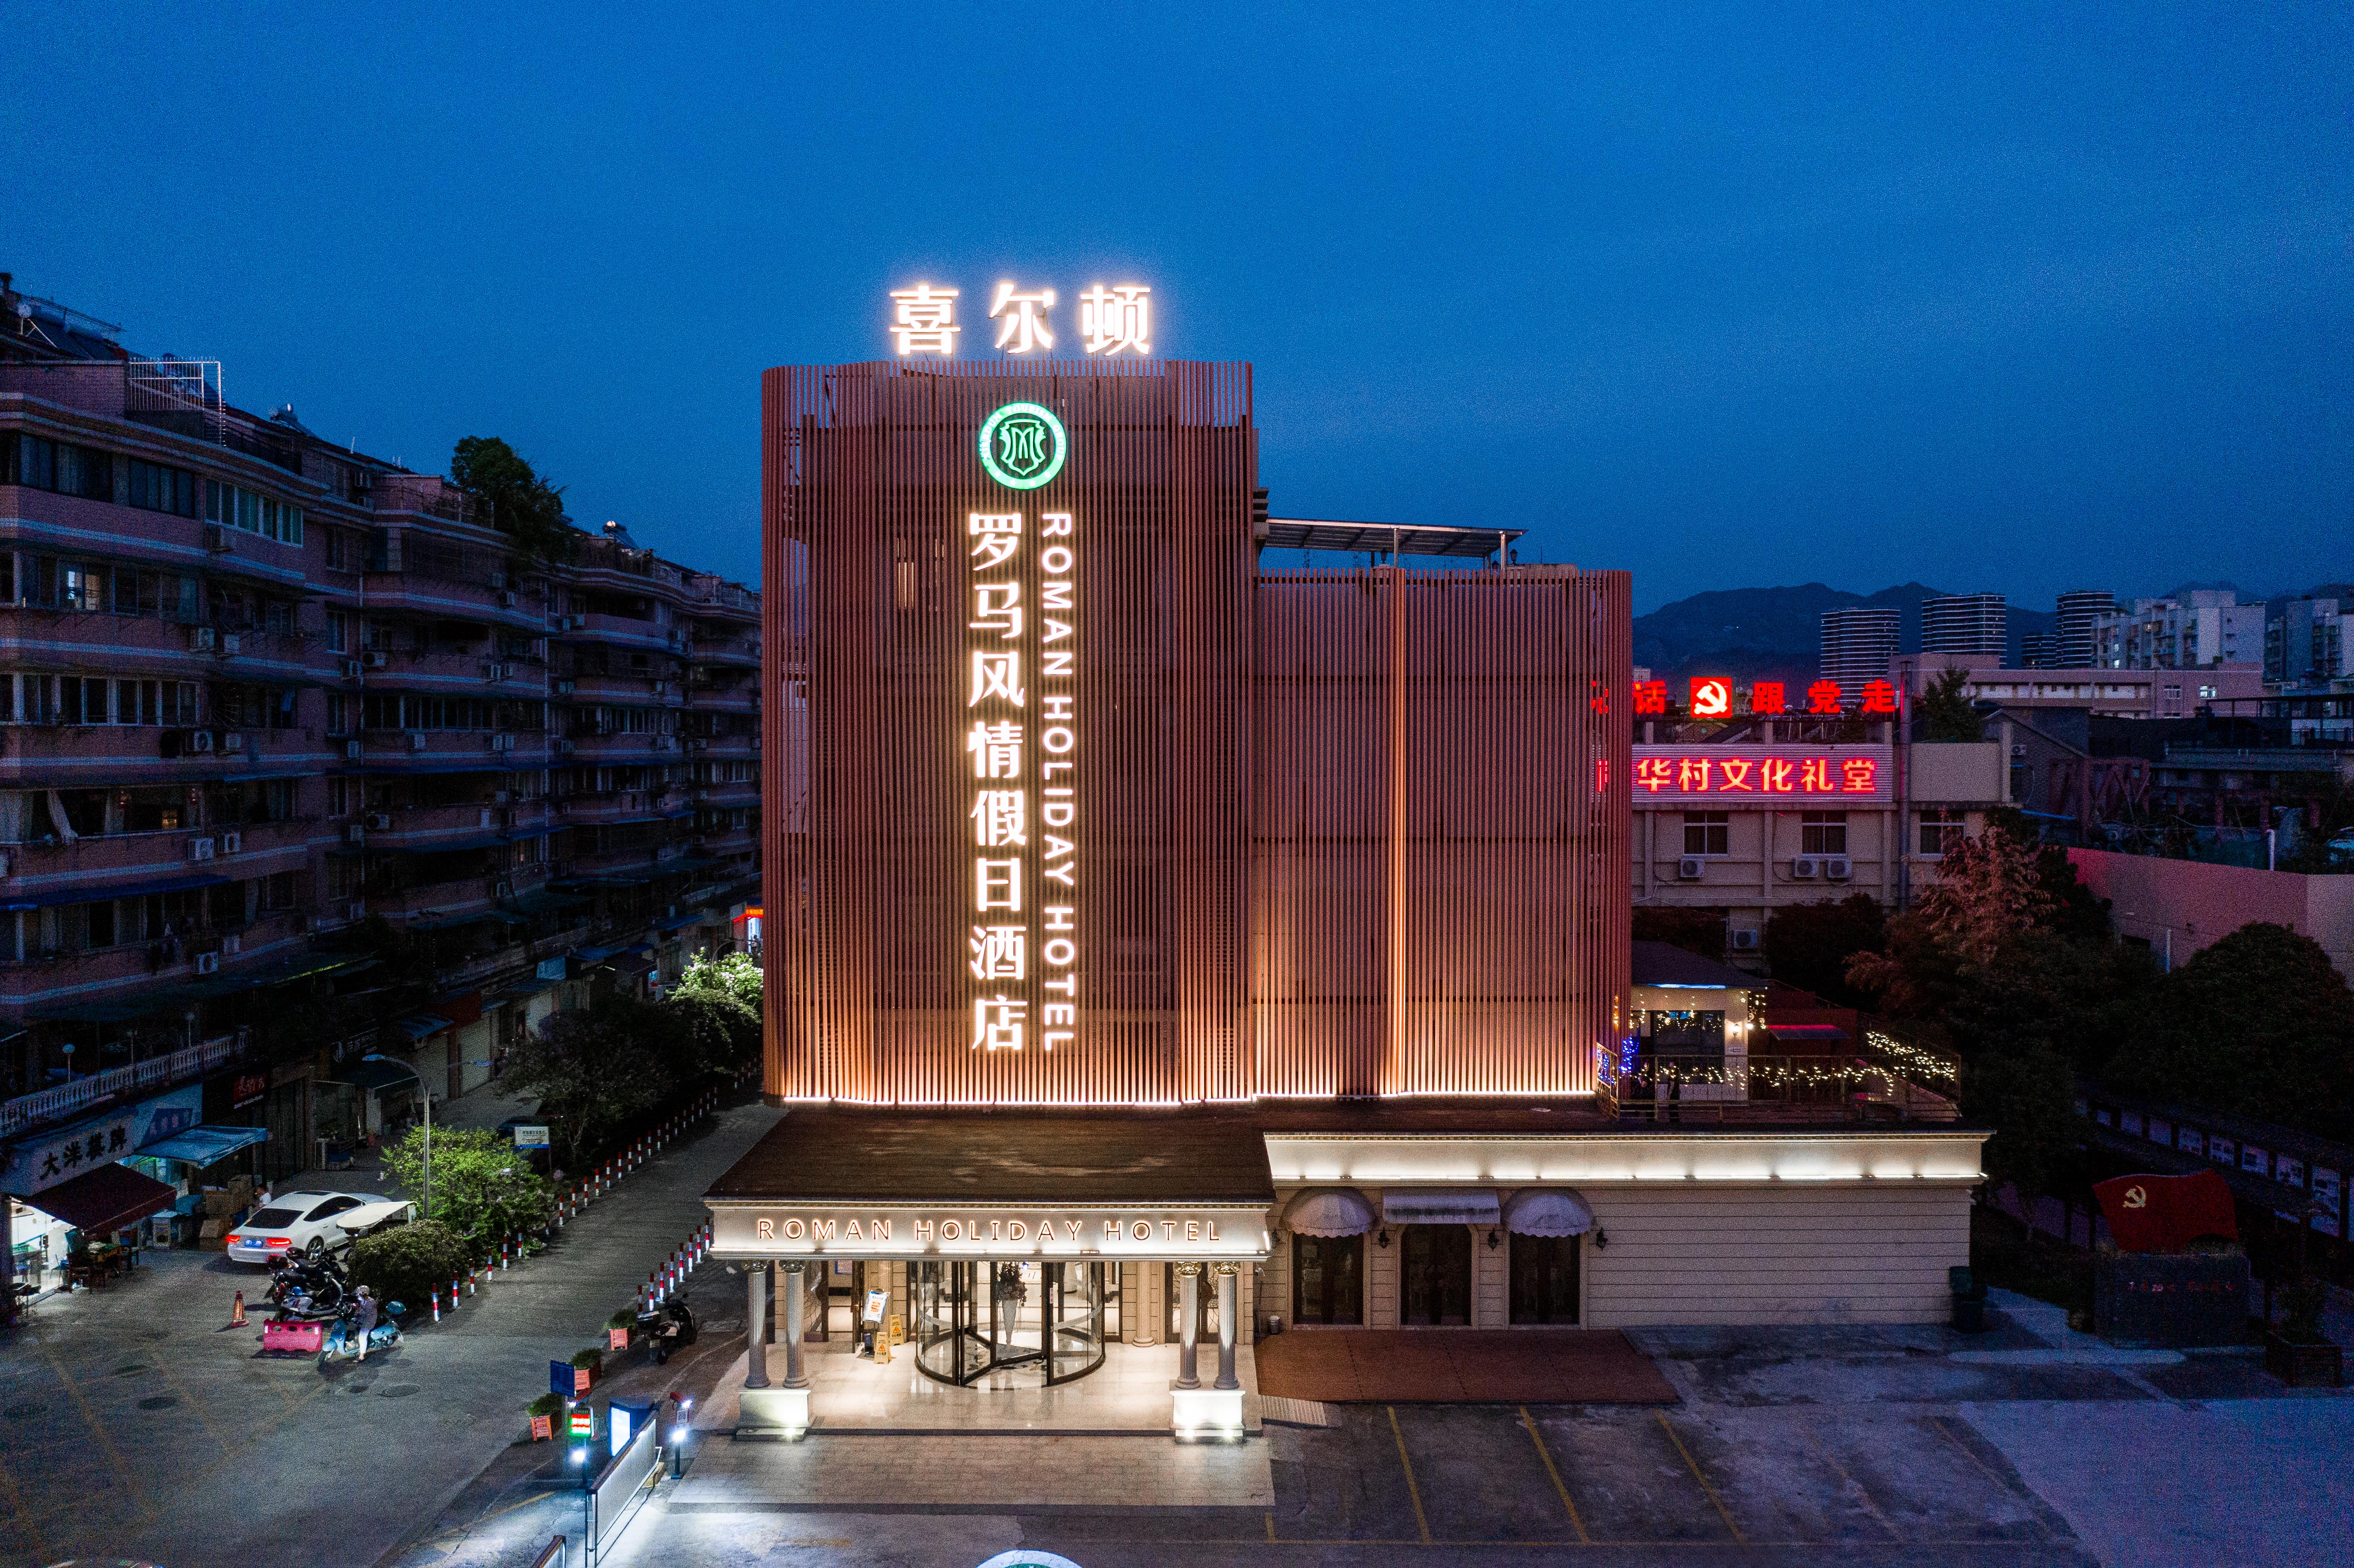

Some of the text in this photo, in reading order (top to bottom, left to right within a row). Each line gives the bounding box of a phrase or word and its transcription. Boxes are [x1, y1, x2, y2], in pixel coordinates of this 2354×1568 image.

[889, 284, 1151, 357] 喜尔顿
[1005, 404, 1052, 422] TOURISM
[1052, 424, 1065, 461] GROUP
[968, 513, 1028, 1051] 罗马风情假日酒店
[1042, 513, 1075, 1051] ROMAN HOLIDAY HOTEL
[1597, 758, 1877, 793] 华村文化礼堂
[40, 1125, 127, 1180] 大洋棋牌
[758, 1220, 1220, 1241] ROMAN HOLIDAY HOTEL
